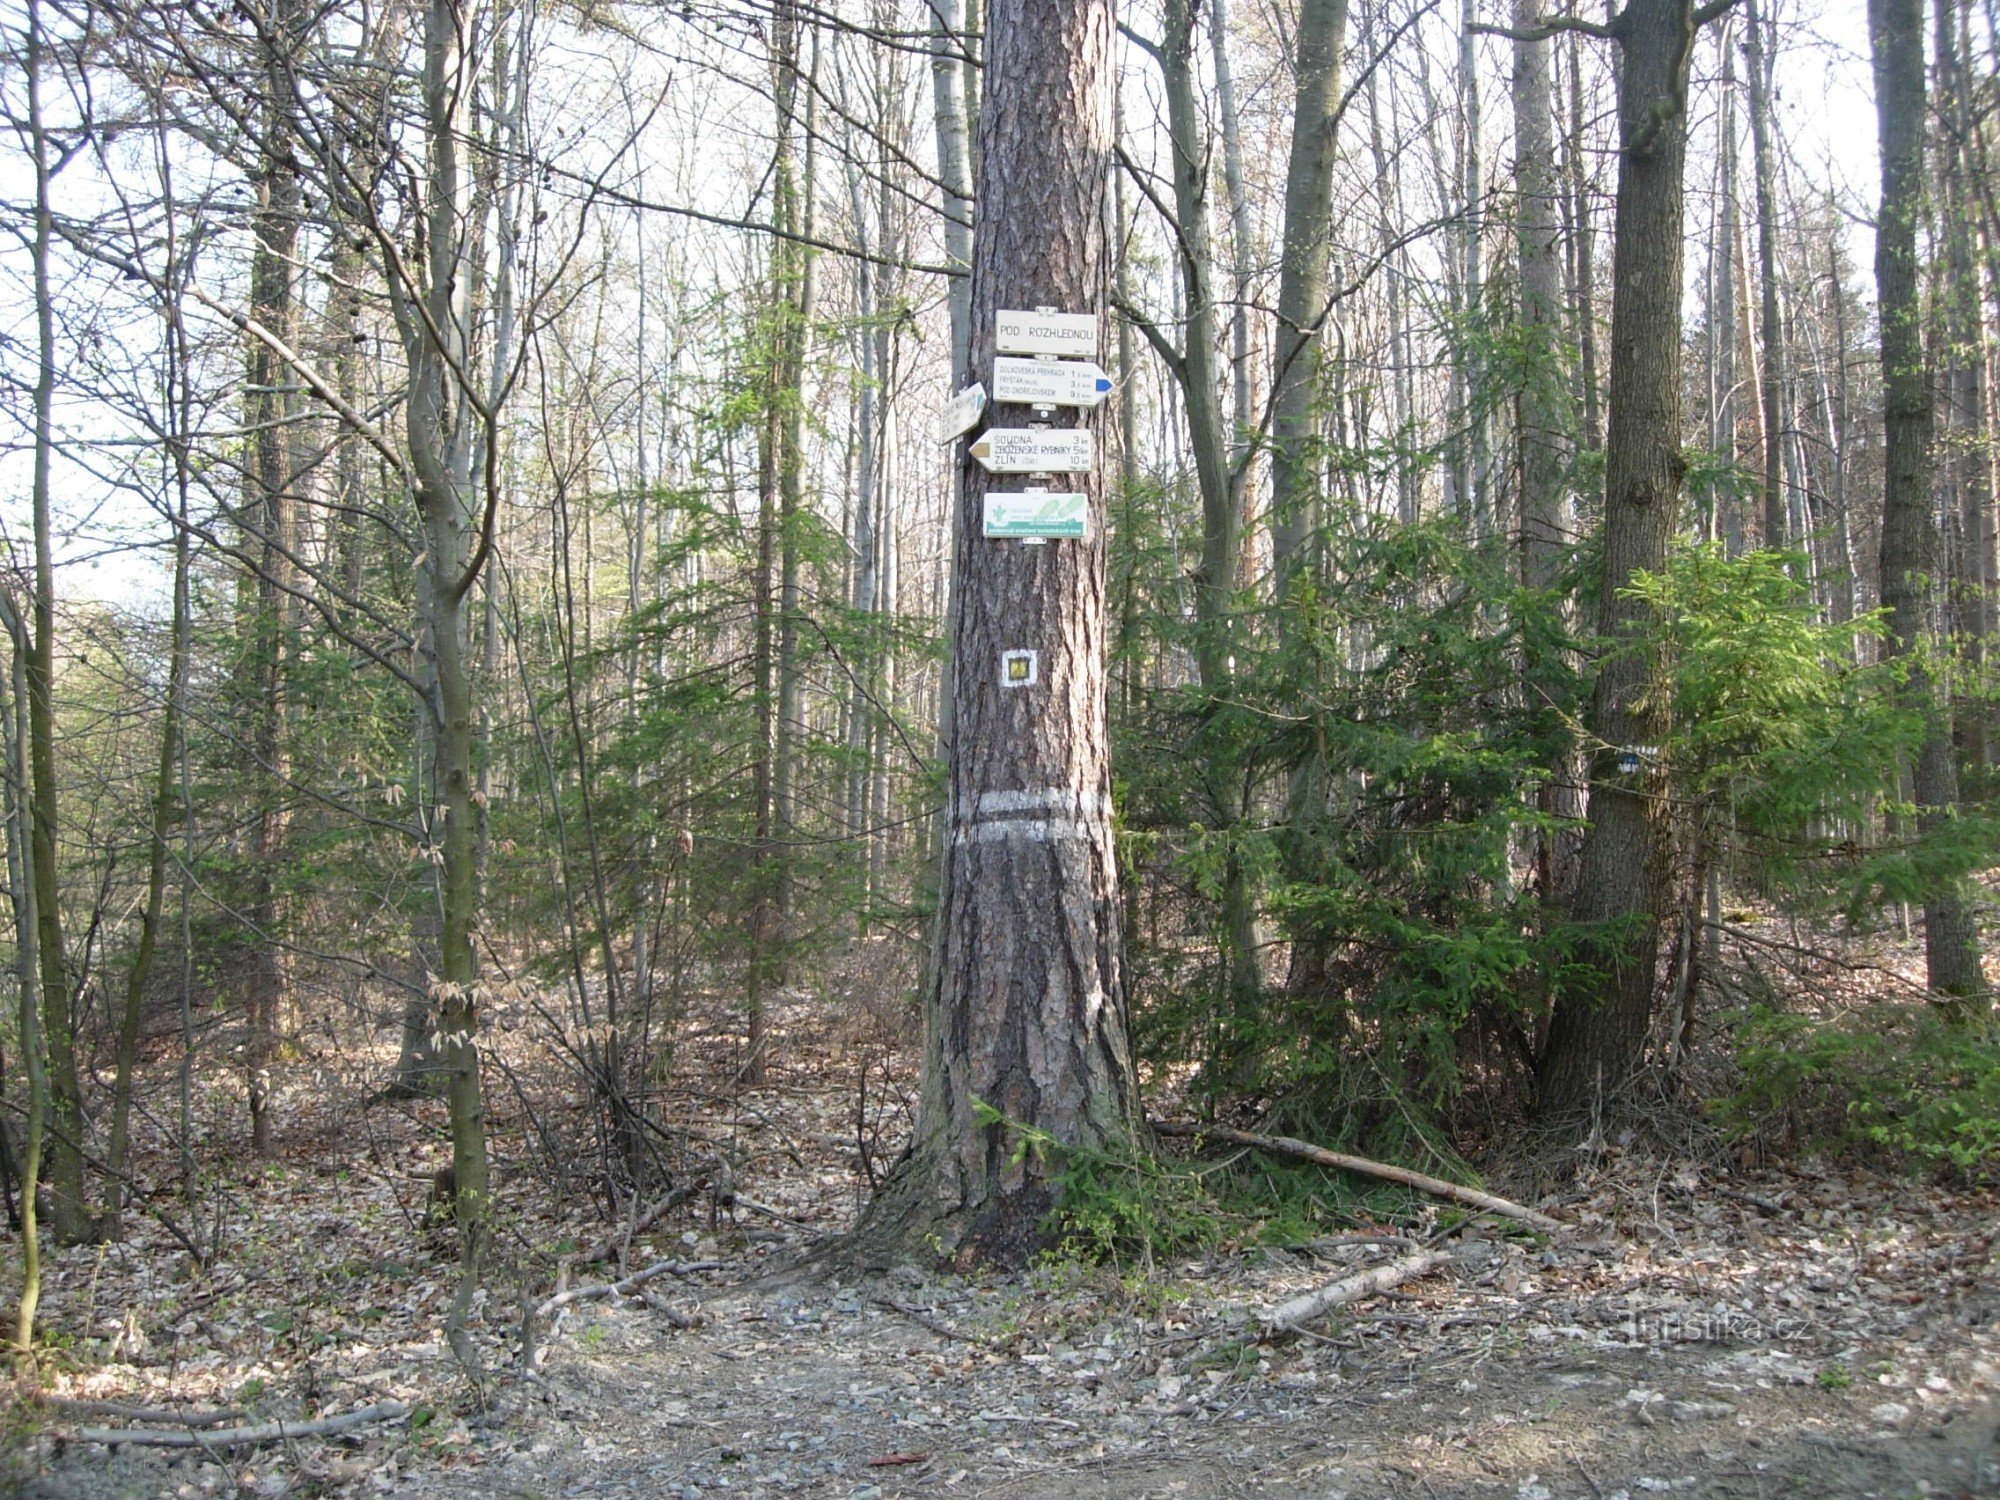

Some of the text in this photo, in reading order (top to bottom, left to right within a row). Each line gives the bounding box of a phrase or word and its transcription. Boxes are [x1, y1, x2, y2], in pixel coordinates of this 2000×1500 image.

[1000, 325, 1094, 340] POD ROZHLEDNOU
[994, 454, 1016, 464] ZLÍN
[1070, 456, 1080, 465] 10
